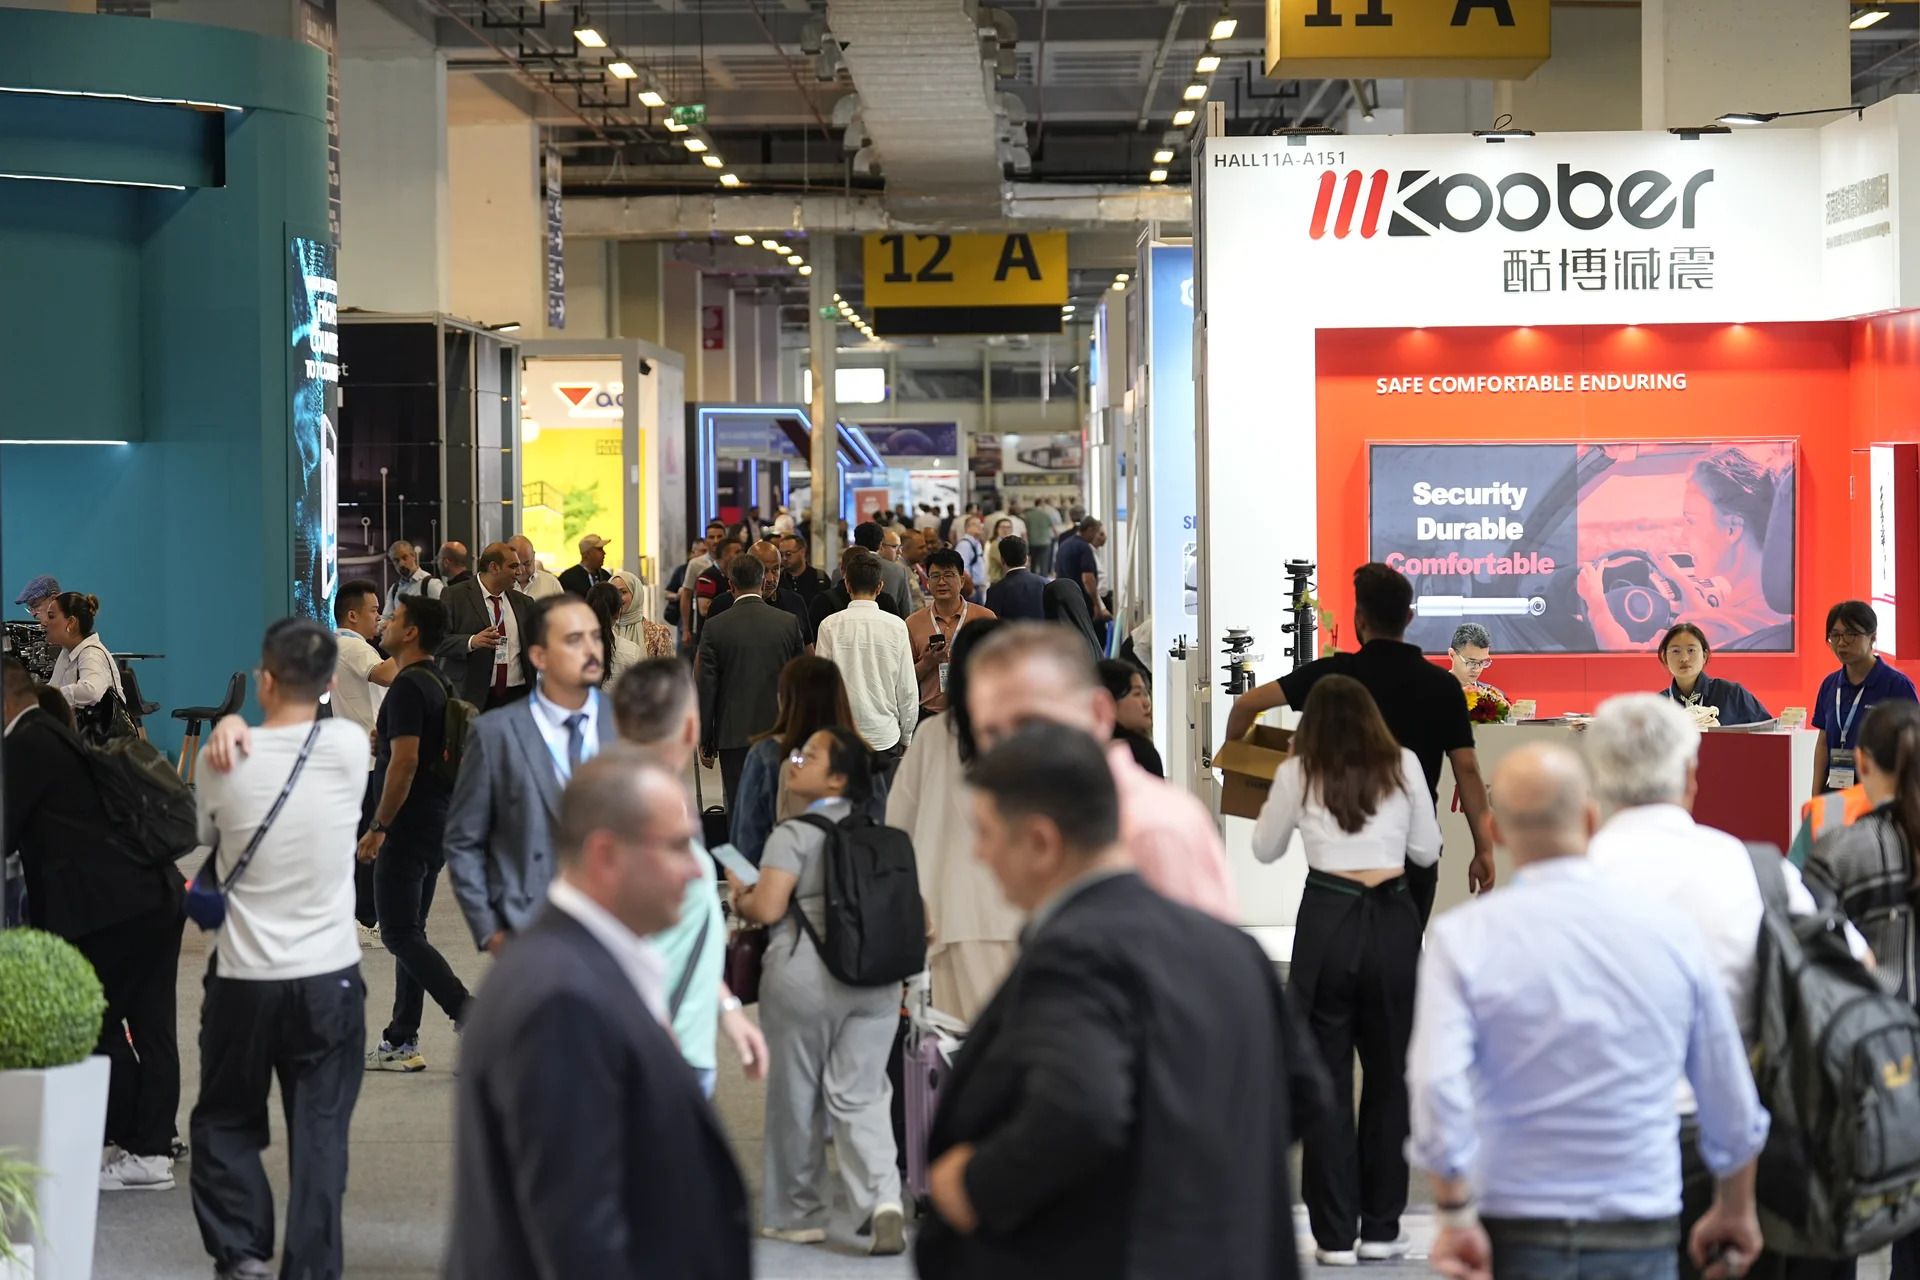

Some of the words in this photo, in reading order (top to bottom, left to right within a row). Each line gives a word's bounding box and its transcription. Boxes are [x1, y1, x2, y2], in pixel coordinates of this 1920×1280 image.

[1214, 151, 1345, 168] HALL11A-A151
[1388, 163, 1714, 237] Koober
[880, 234, 954, 282] 12
[994, 233, 1042, 281] A
[1376, 377, 1424, 394] SAFE
[1429, 375, 1574, 394] COMFORTABLE
[1580, 373, 1687, 391] ENDURING
[1413, 481, 1528, 511] Security
[1417, 517, 1524, 540] Durable
[1386, 552, 1555, 575] Comfortable
